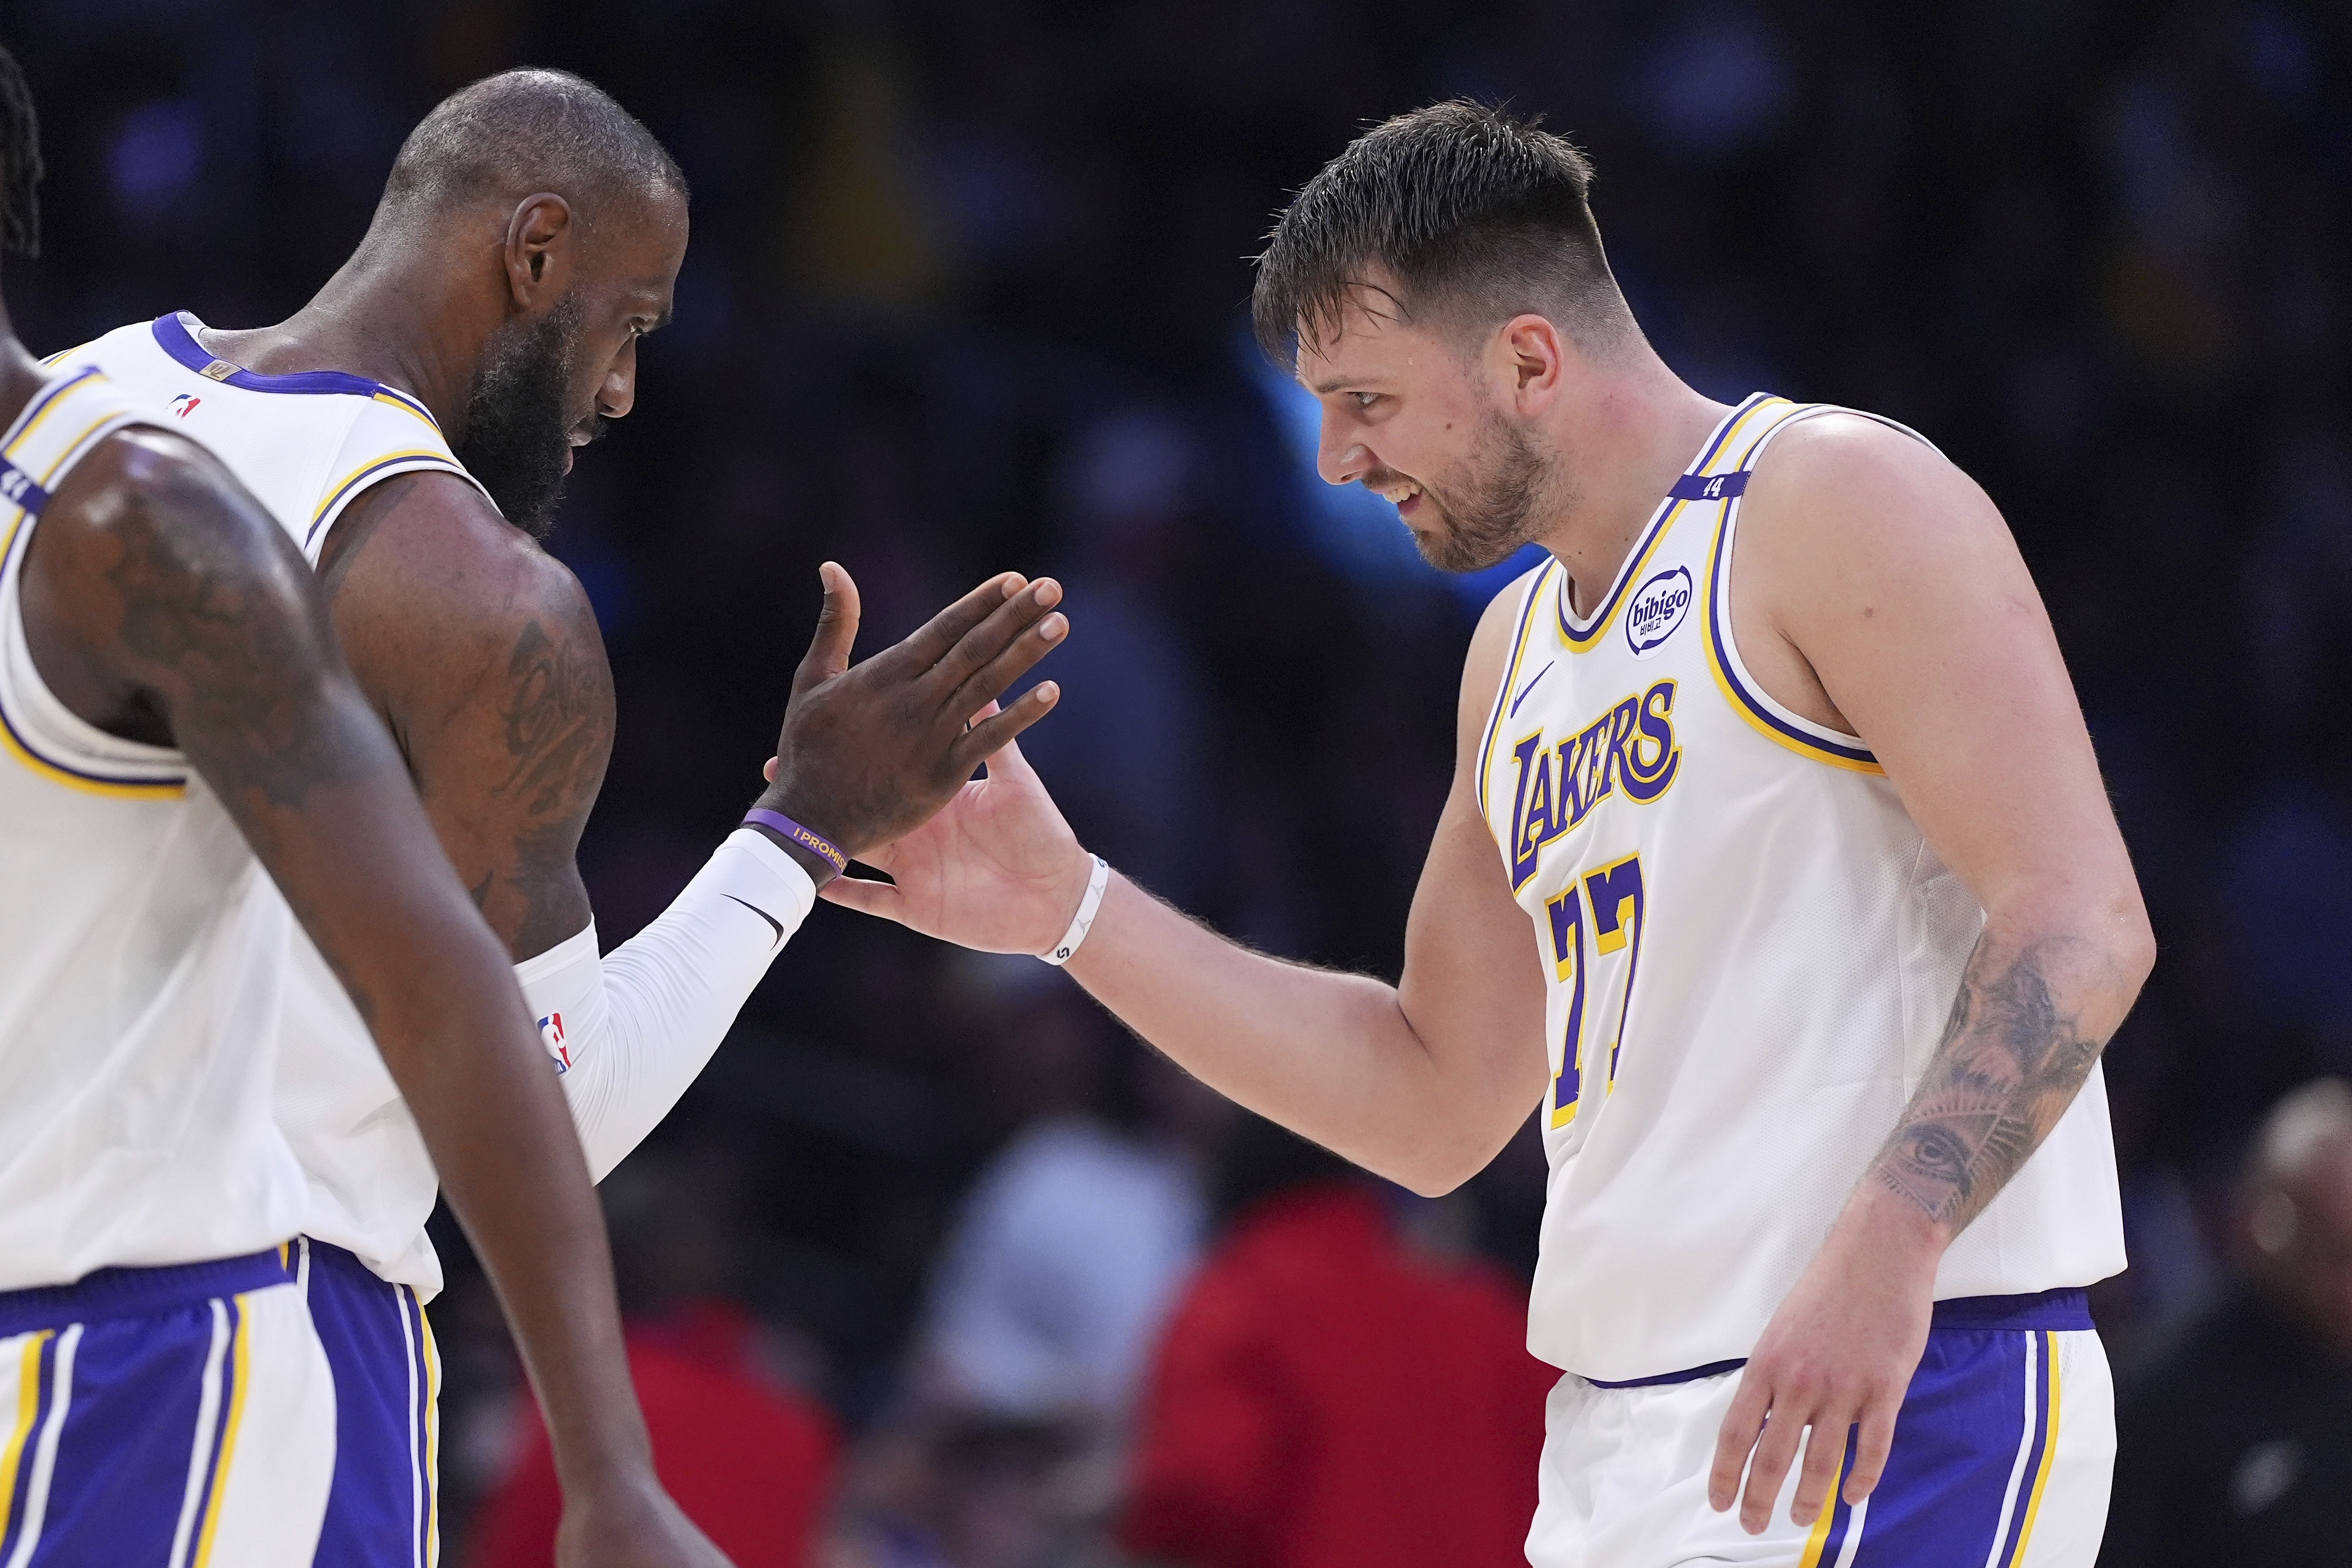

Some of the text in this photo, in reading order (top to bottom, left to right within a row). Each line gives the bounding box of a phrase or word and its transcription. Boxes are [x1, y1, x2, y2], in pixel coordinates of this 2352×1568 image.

[1702, 477, 1725, 497] 44
[1633, 589, 1688, 627] bibigo
[1639, 617, 1662, 636] 비비고
[1510, 677, 1683, 895] LAKERS
[793, 827, 800, 837] I
[1544, 849, 1646, 1131] 77
